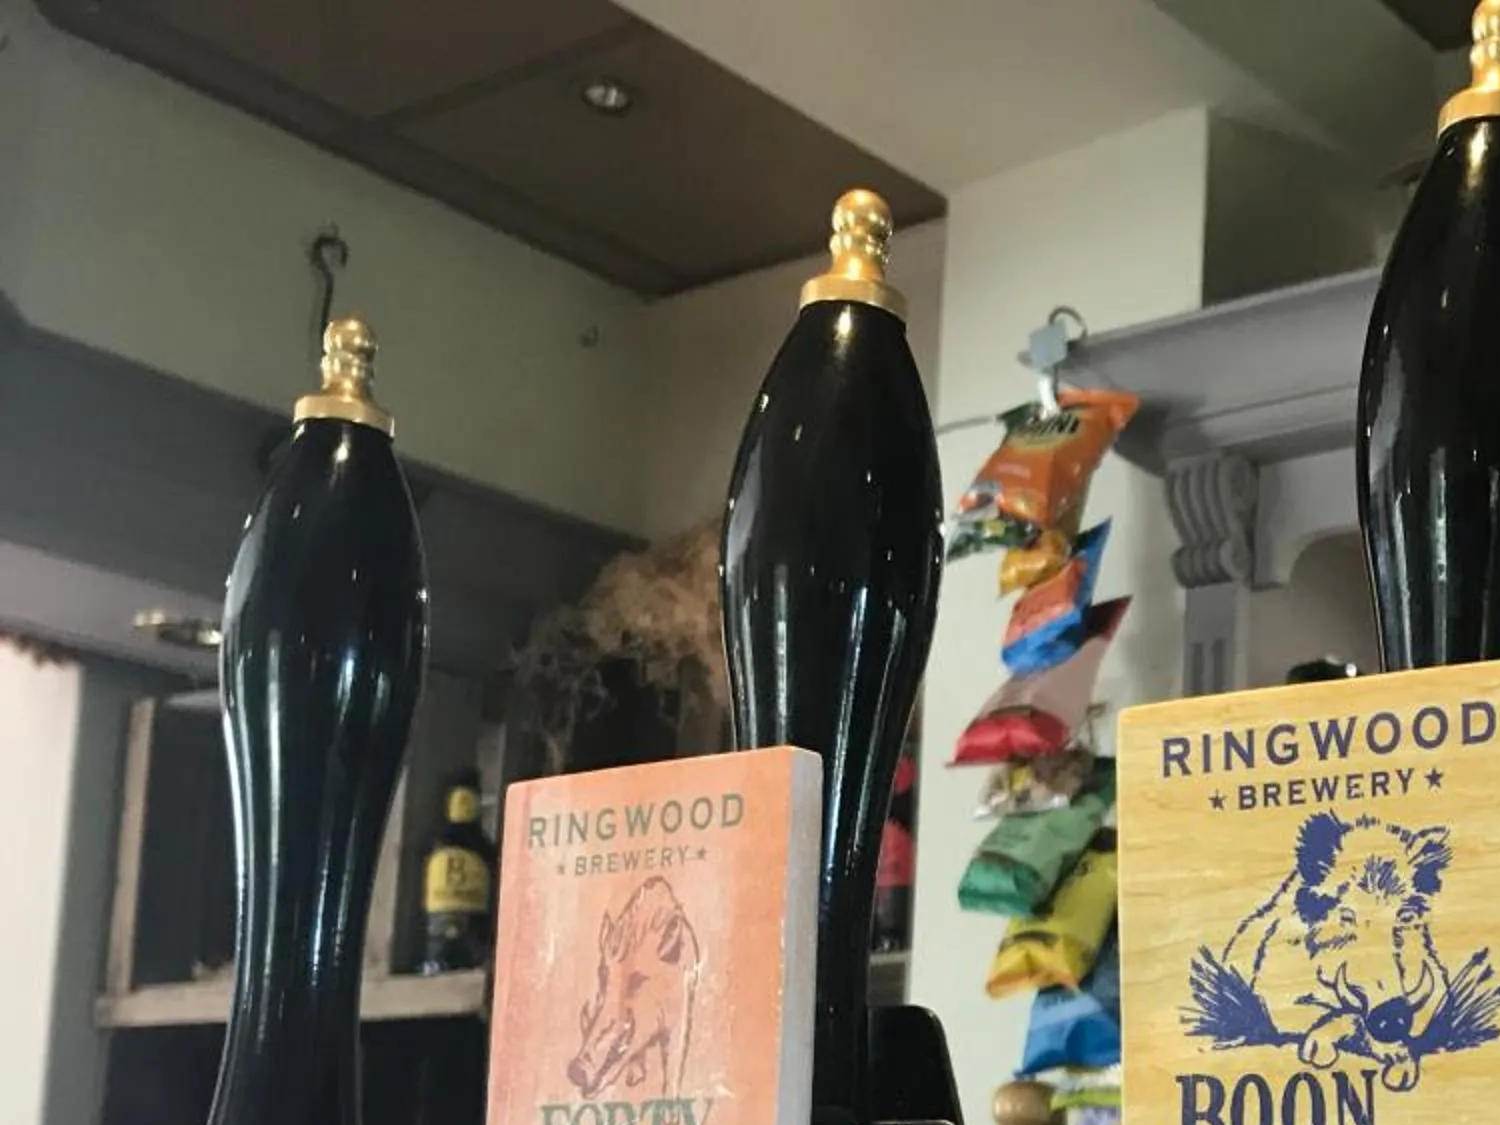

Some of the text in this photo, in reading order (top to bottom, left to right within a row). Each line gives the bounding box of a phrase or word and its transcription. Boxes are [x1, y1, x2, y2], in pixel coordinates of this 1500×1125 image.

[1161, 701, 1498, 778] RINGWOOD
[1237, 768, 1416, 811] BREWERY
[527, 794, 745, 849] RINGWOOD
[573, 847, 689, 876] BREWERY
